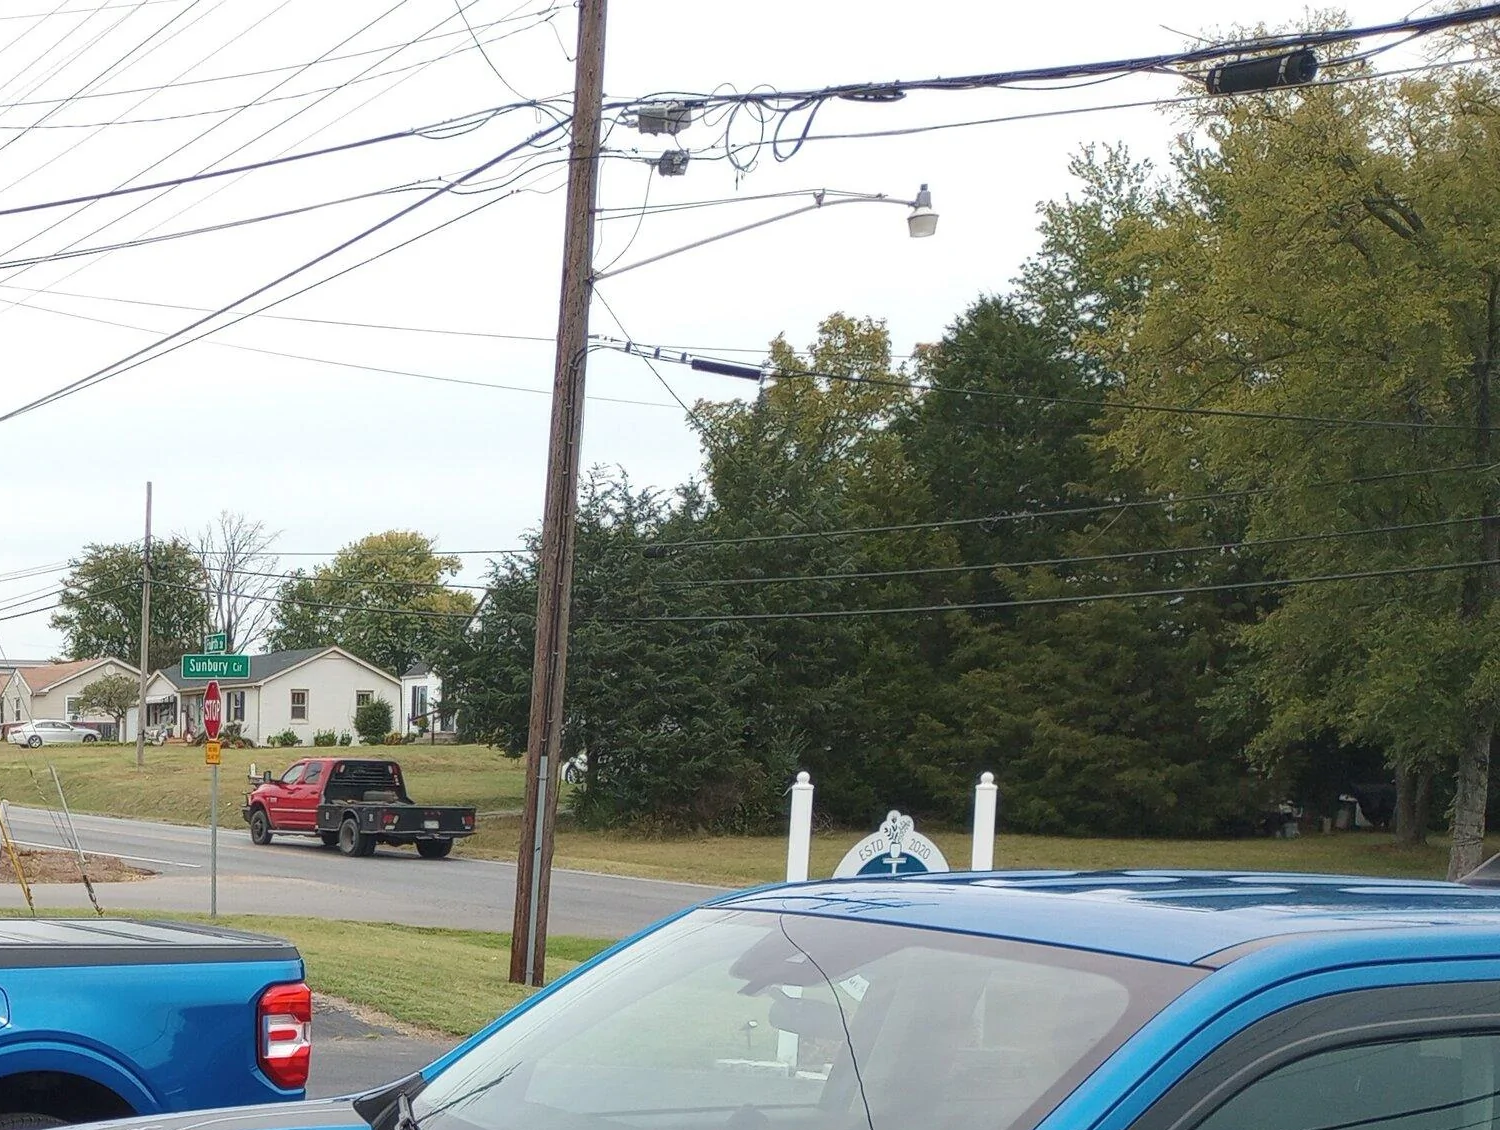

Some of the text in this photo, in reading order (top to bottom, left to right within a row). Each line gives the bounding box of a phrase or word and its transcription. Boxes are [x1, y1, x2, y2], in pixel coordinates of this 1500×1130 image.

[189, 658, 242, 675] Sunbury Cir
[204, 699, 220, 721] STOP
[858, 838, 931, 861] ESTD 2020
